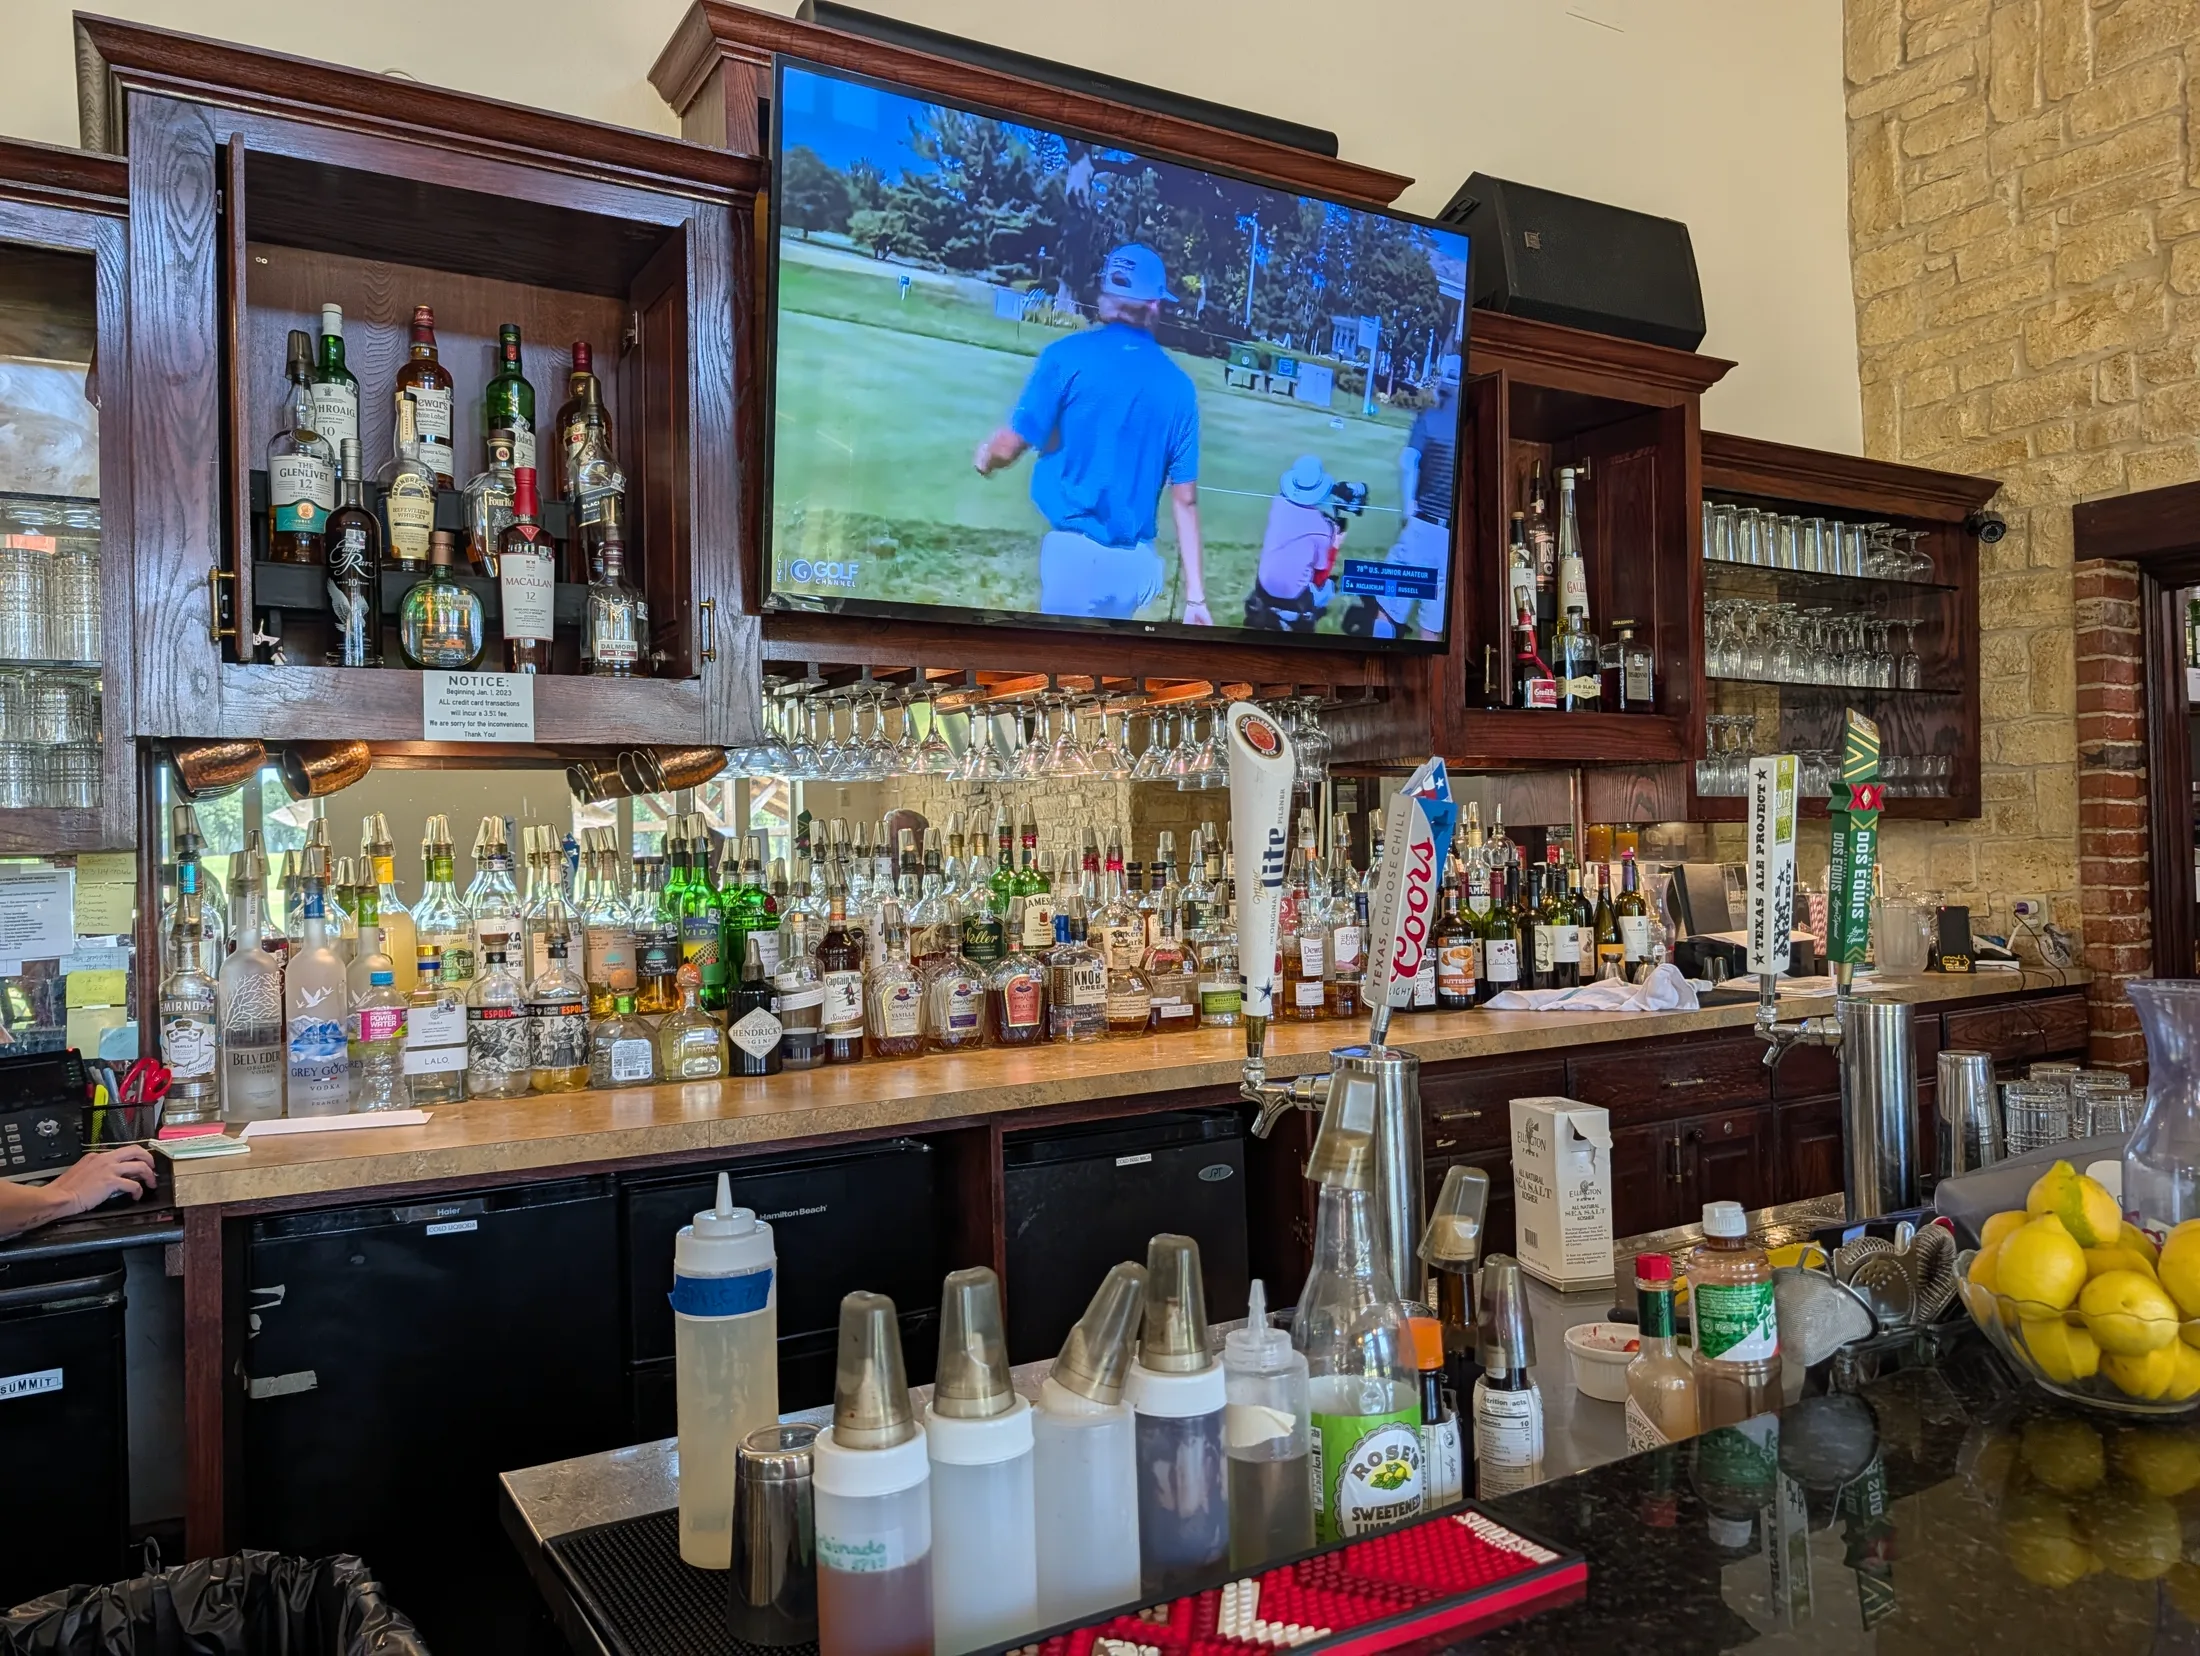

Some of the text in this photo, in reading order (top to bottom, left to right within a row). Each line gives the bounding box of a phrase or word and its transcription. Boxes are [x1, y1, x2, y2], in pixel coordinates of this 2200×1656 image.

[417, 398, 448, 411] ewar's
[312, 404, 356, 418] HROAIG
[431, 413, 446, 421] Label
[322, 426, 336, 437] 10
[298, 462, 314, 470] THE
[279, 468, 328, 482] GLENLIVET
[299, 479, 313, 489] 12
[398, 513, 426, 521] WHISKEY
[333, 553, 377, 579] Rare
[813, 560, 859, 580] GOLF
[1369, 566, 1380, 574] U.S.
[1381, 568, 1402, 576] JUNIOR
[1402, 570, 1429, 579] AMATEUR
[348, 578, 358, 587] 10
[505, 577, 552, 588] MACALLAN
[815, 578, 857, 588] CHANNEL
[525, 591, 536, 601] 12
[601, 643, 637, 651] DALMORE
[449, 676, 510, 687] NOTICE:
[446, 688, 475, 697] Beginning
[451, 721, 466, 729] sorry
[1249, 716, 1276, 735] PILSNER
[1277, 787, 1287, 825] PILSNER
[1755, 783, 1767, 950] TEXAS ALE PROJECT
[1830, 832, 1845, 892] DOS EQUIS
[1851, 831, 1870, 919] DOS EQUIS
[1252, 868, 1264, 905] Miller
[1024, 896, 1051, 910] JAMES
[1371, 810, 1406, 987] TEXAS, CHOOSE CHILL
[1270, 893, 1278, 935] ORIGINAL
[1390, 836, 1435, 982] Coors
[684, 928, 718, 937] VIDA
[825, 974, 851, 987] Captain
[1074, 971, 1100, 986] KNOB
[1079, 983, 1106, 992] CREEK
[1388, 986, 1412, 997] LIGHT
[830, 1013, 852, 1022] Spiced
[370, 1020, 397, 1028] WATER
[732, 1026, 782, 1037] HENDRICK'S
[751, 1037, 768, 1045] GIN
[247, 1064, 277, 1072] ORGANIC
[291, 1066, 318, 1078] GREY
[310, 1083, 341, 1091] VODKA
[1525, 1170, 1545, 1186] NATURAL
[1527, 1181, 1552, 1199] SALT
[1521, 1190, 1539, 1205] KOSHER
[437, 1207, 461, 1216] Haier
[759, 1205, 826, 1221] Hamilton Beach
[428, 1225, 447, 1233] COLD
[0, 1378, 52, 1395] SUMMIT
[1511, 1399, 1527, 1407] acts
[1351, 1443, 1420, 1482] ROSE'S
[1351, 1493, 1421, 1522] SWEETENED
